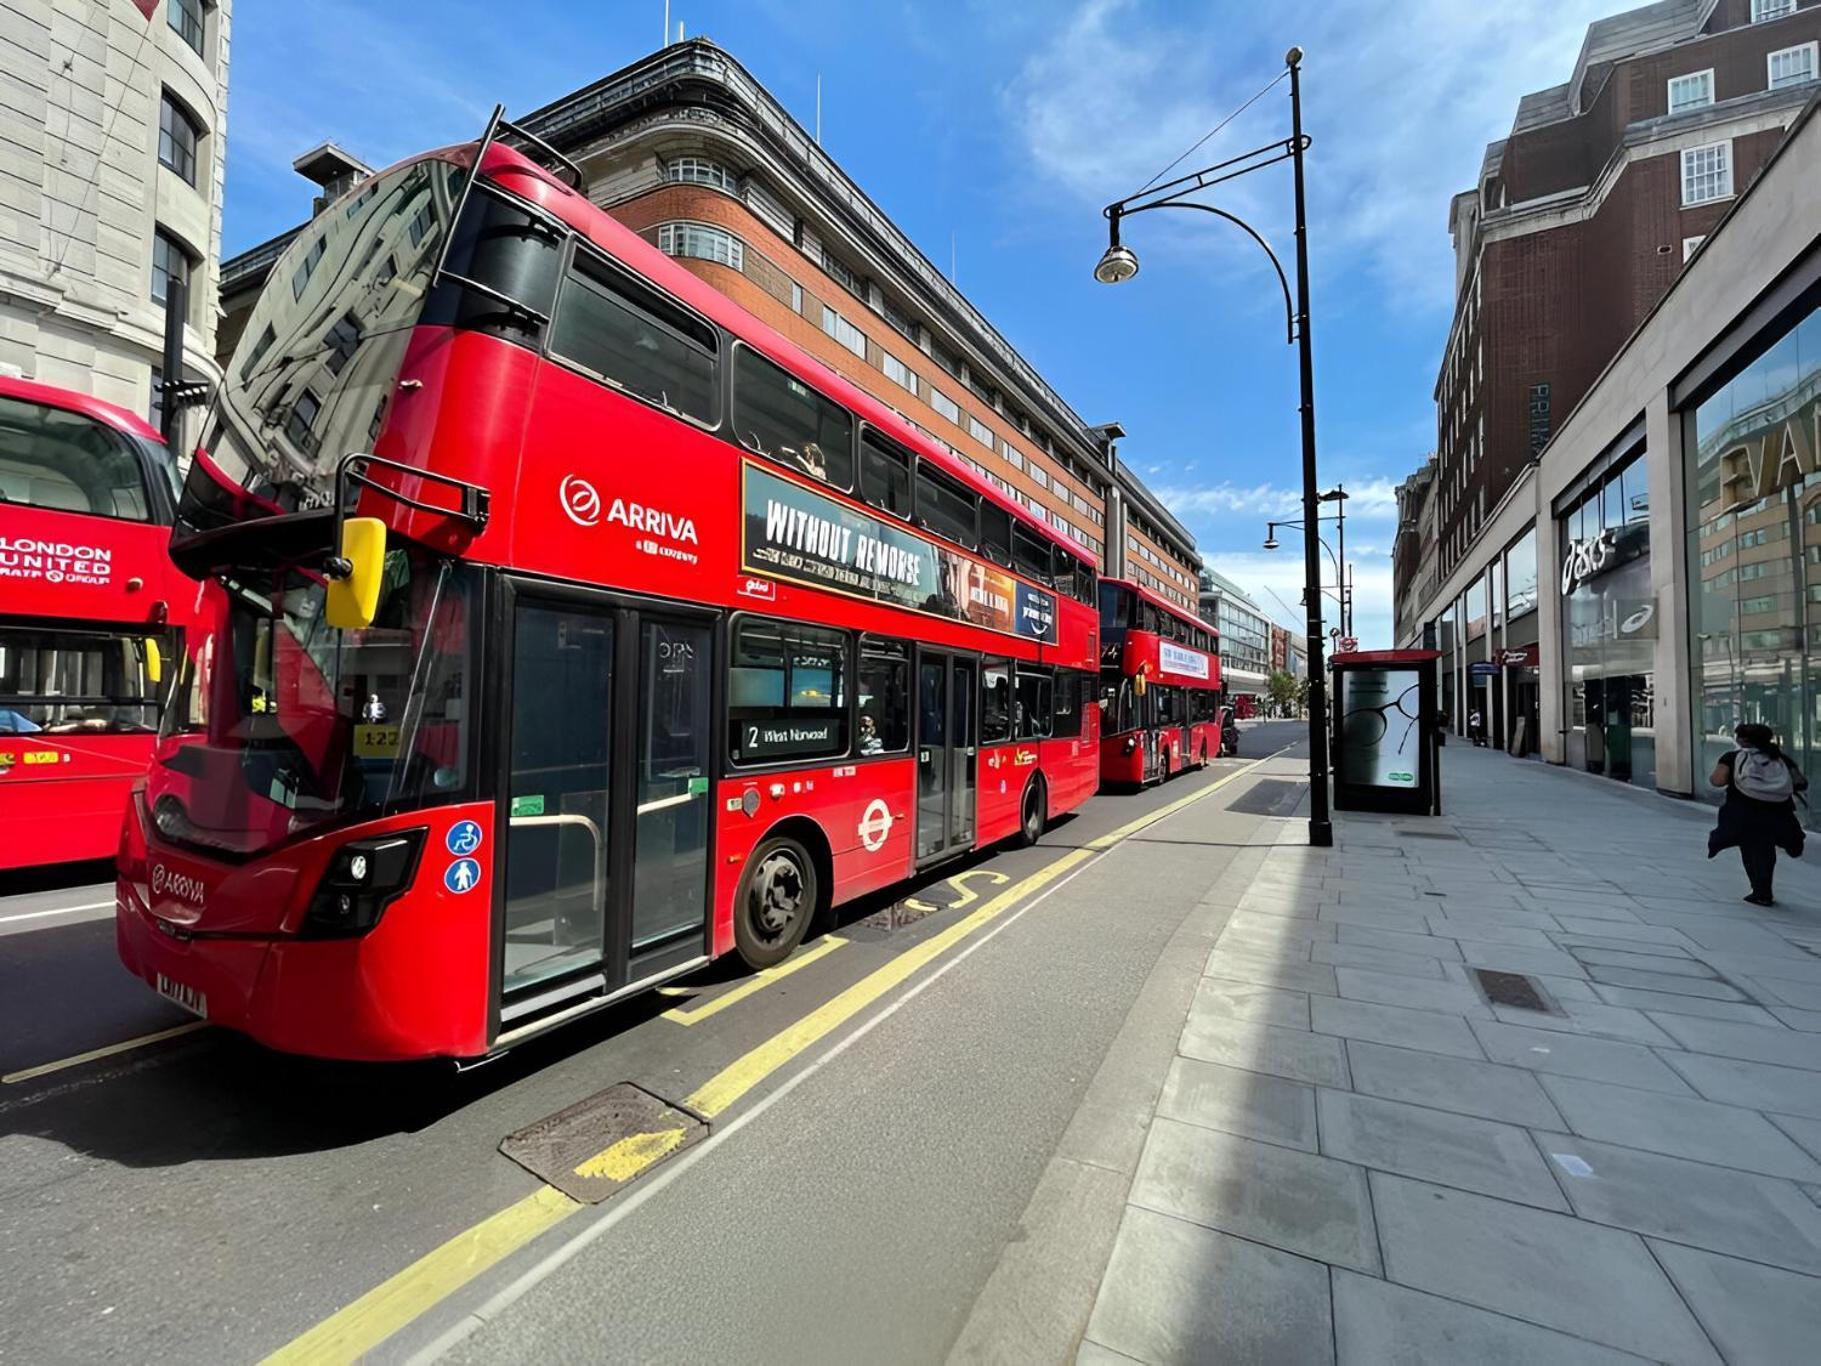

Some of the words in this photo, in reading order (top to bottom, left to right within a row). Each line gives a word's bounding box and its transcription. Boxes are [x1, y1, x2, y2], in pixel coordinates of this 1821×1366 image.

[607, 498, 699, 545] ARRIVA
[0, 537, 111, 561] LONDON
[766, 499, 851, 564] WITHOUT
[856, 534, 920, 586] REMORSE
[0, 552, 111, 575] UNITED
[748, 726, 759, 748] 2
